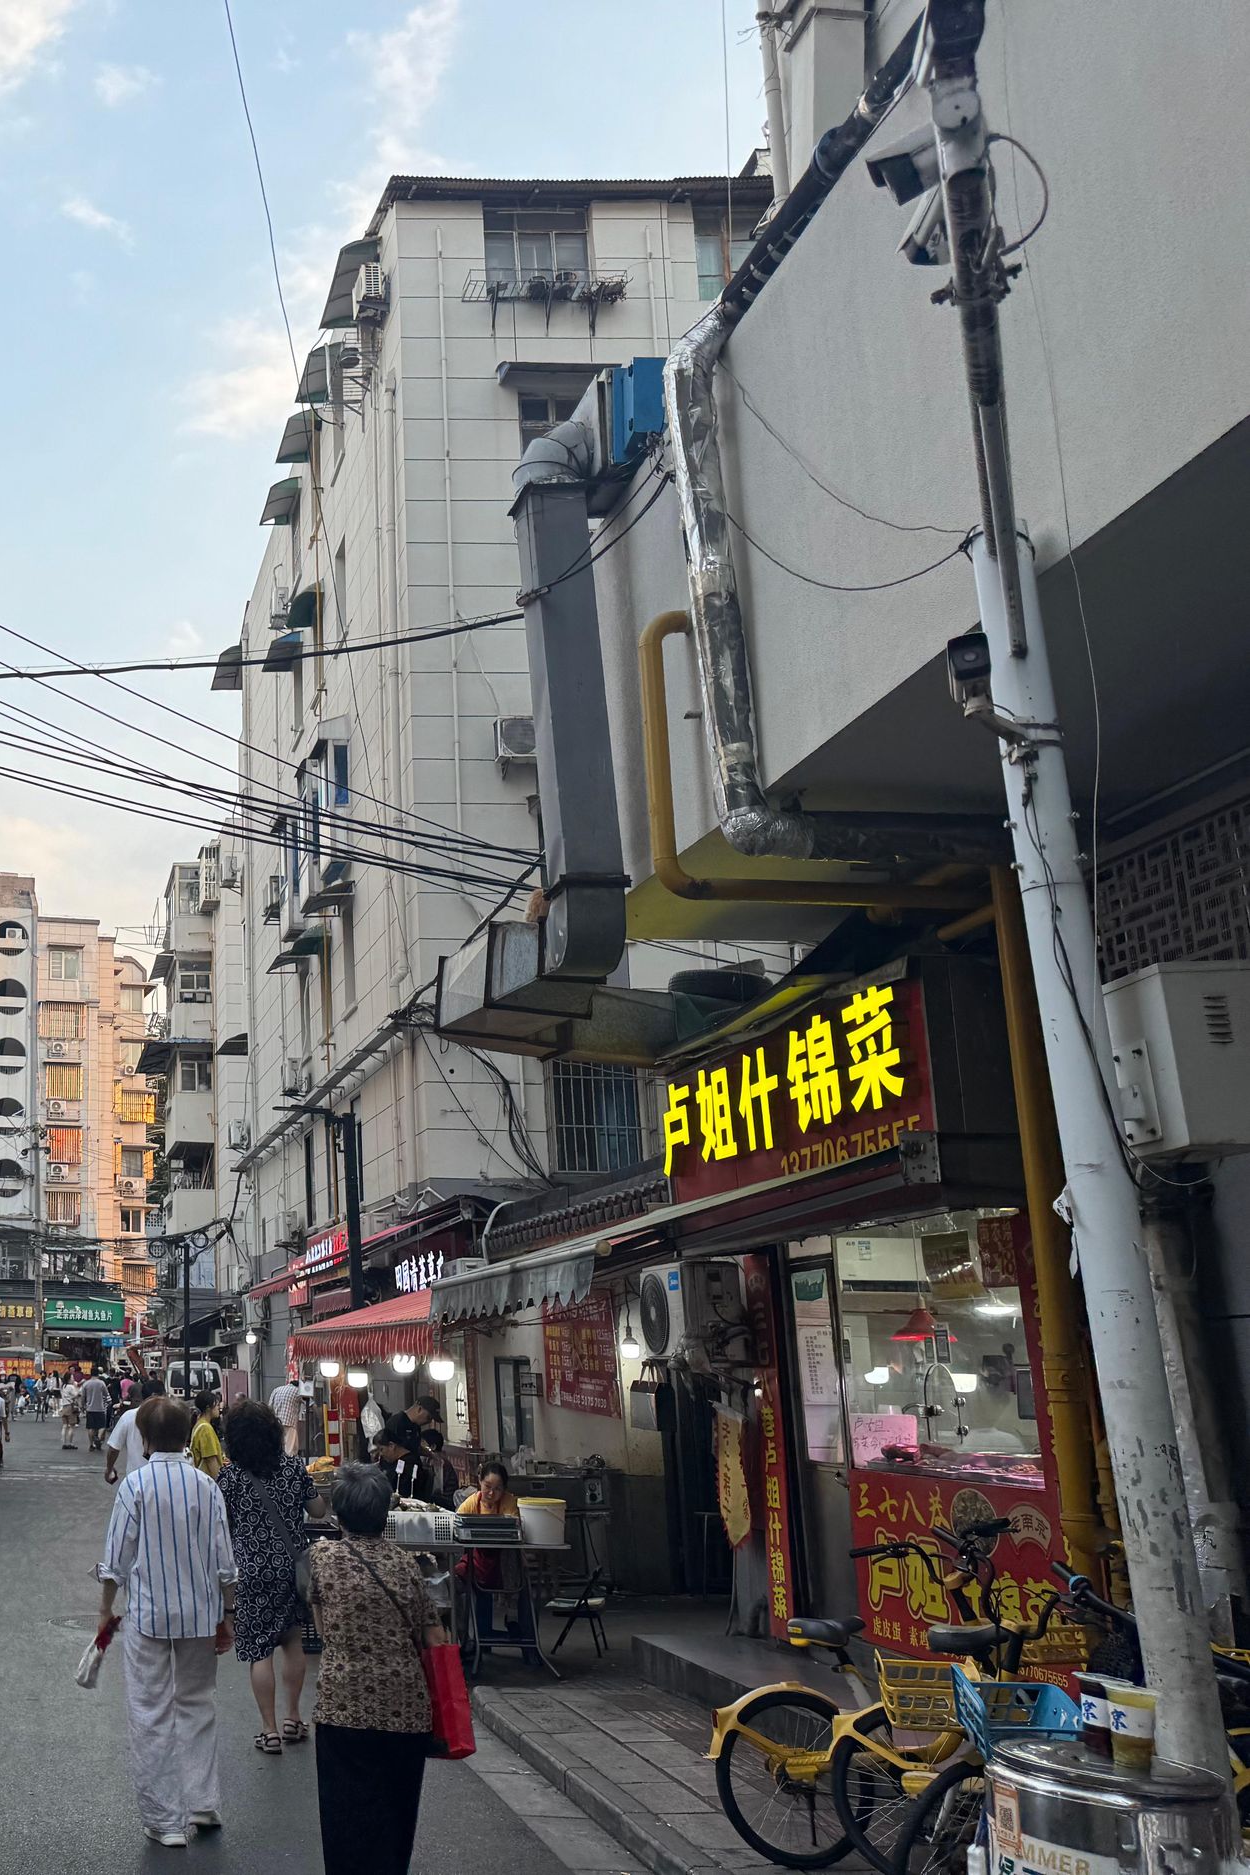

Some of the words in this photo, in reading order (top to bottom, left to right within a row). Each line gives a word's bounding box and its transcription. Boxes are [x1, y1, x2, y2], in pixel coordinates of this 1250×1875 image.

[662, 984, 905, 1177] 卢姐什锦菜
[872, 1616, 903, 1643] 虎皮蛋
